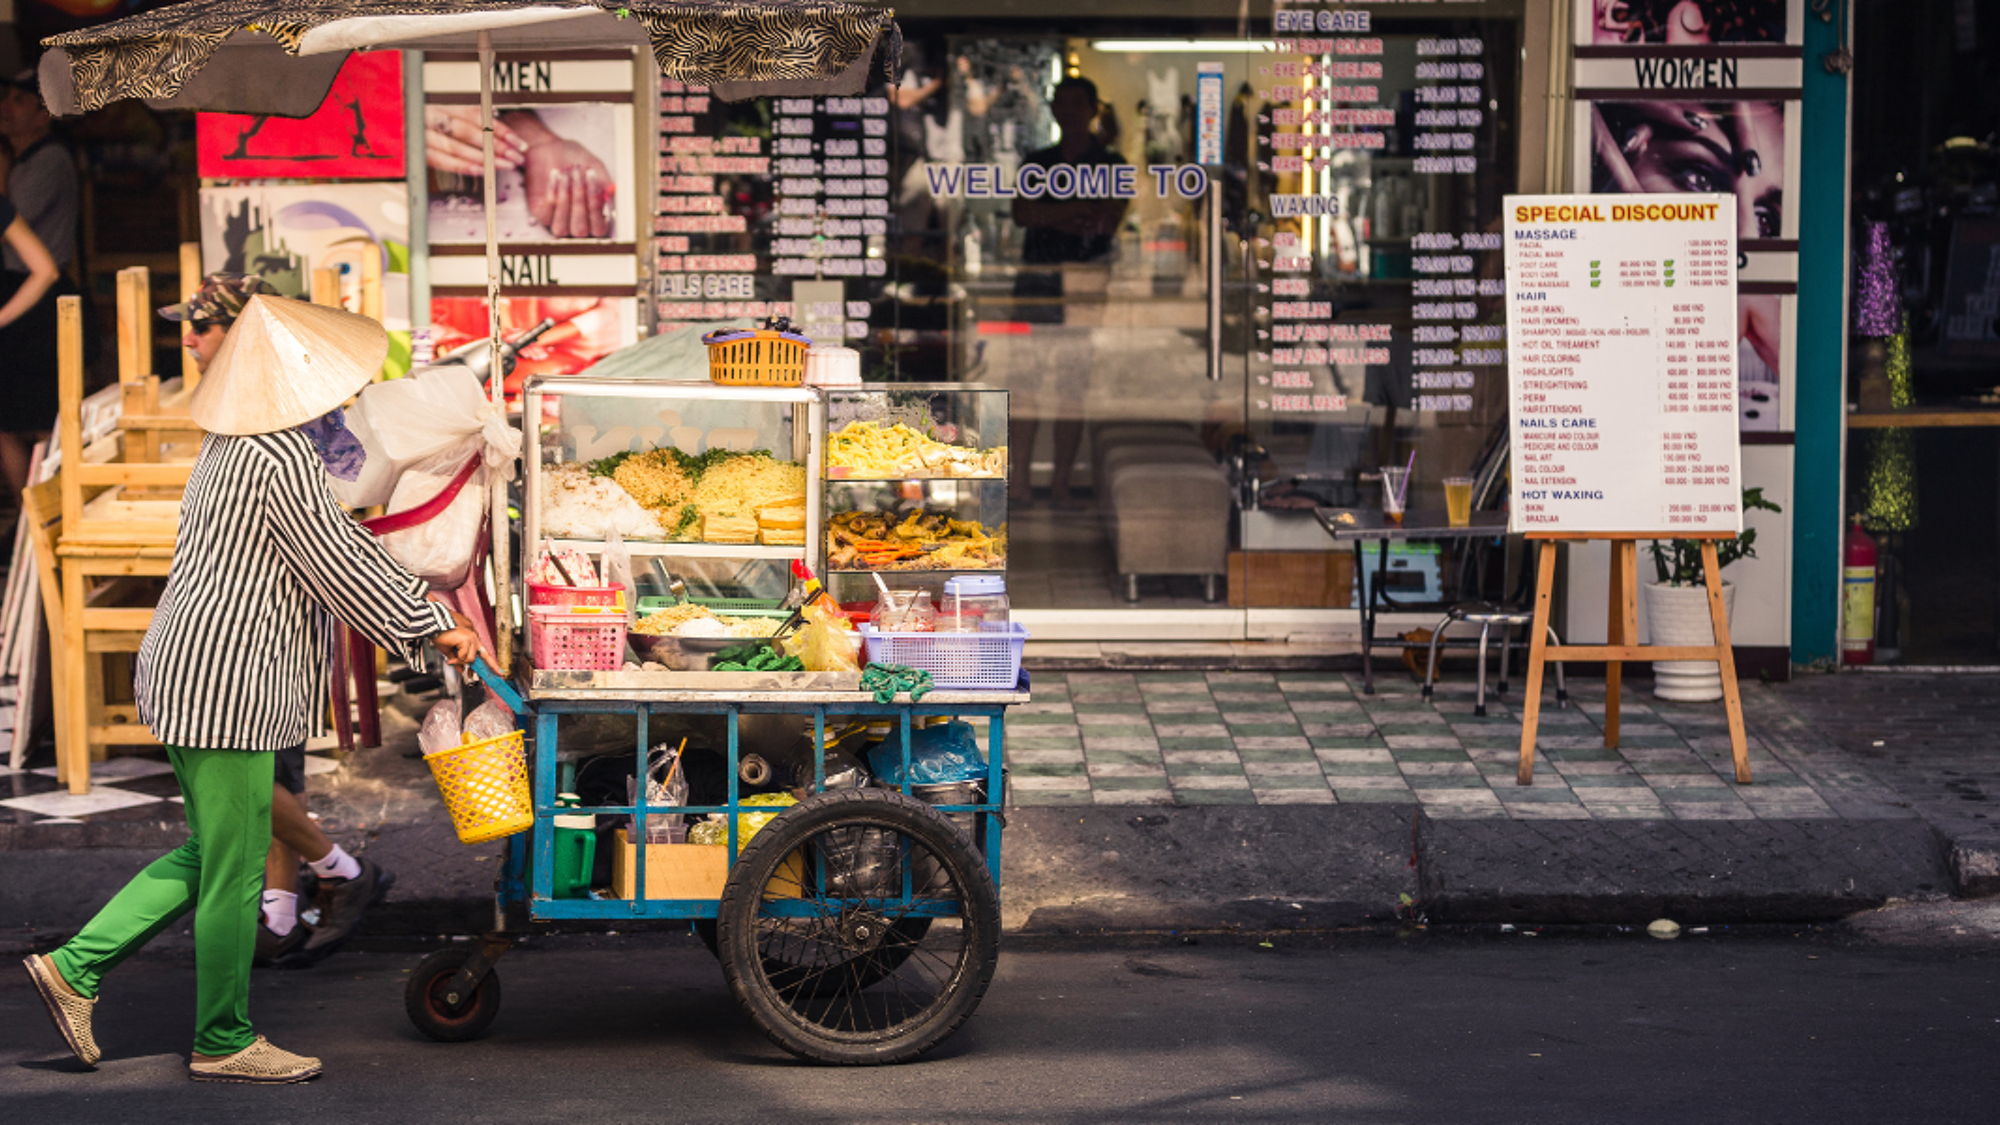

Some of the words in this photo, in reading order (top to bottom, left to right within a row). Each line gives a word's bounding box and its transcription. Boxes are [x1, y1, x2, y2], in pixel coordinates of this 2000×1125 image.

[1275, 10, 1314, 32] EYE
[1316, 10, 1371, 32] CARE
[1274, 63, 1297, 78] EYE
[1635, 57, 1738, 89] WOMEN
[493, 61, 551, 92] MEN
[1273, 86, 1297, 102] EYE
[1272, 109, 1296, 126] EYE
[1271, 133, 1295, 149] EYE
[925, 163, 1137, 199] WELCOME
[1150, 163, 1208, 198] TO
[1270, 193, 1339, 218] WAXING
[1515, 205, 1606, 223] SPECIAL
[1611, 204, 1719, 222] DISCOUNT
[1515, 229, 1577, 240] MASSAGE
[501, 254, 558, 285] NAIL
[703, 274, 754, 299] CARE
[1517, 292, 1546, 301] HAIR
[1521, 305, 1539, 314] HAIR
[1542, 306, 1564, 314] (MAN)
[1521, 317, 1540, 326] HAIR
[1543, 317, 1580, 326] (WOMEN)
[1522, 328, 1561, 336] SHAMPOO
[1522, 340, 1538, 349] HOT
[1540, 340, 1553, 349] OIL
[1556, 340, 1600, 349] TREAMENT
[1522, 354, 1540, 363] HAIR
[1542, 354, 1581, 363] COLORING
[1523, 367, 1574, 377] HIGHLIGHTS
[1523, 380, 1588, 390] STREIGHTENING
[1523, 394, 1546, 402] PERM
[1520, 418, 1557, 428] NAILS
[1562, 418, 1597, 428] CARE
[1522, 490, 1547, 499] HOT
[1552, 490, 1603, 499] WAXING
[1526, 515, 1559, 523] BRAZILIAN
